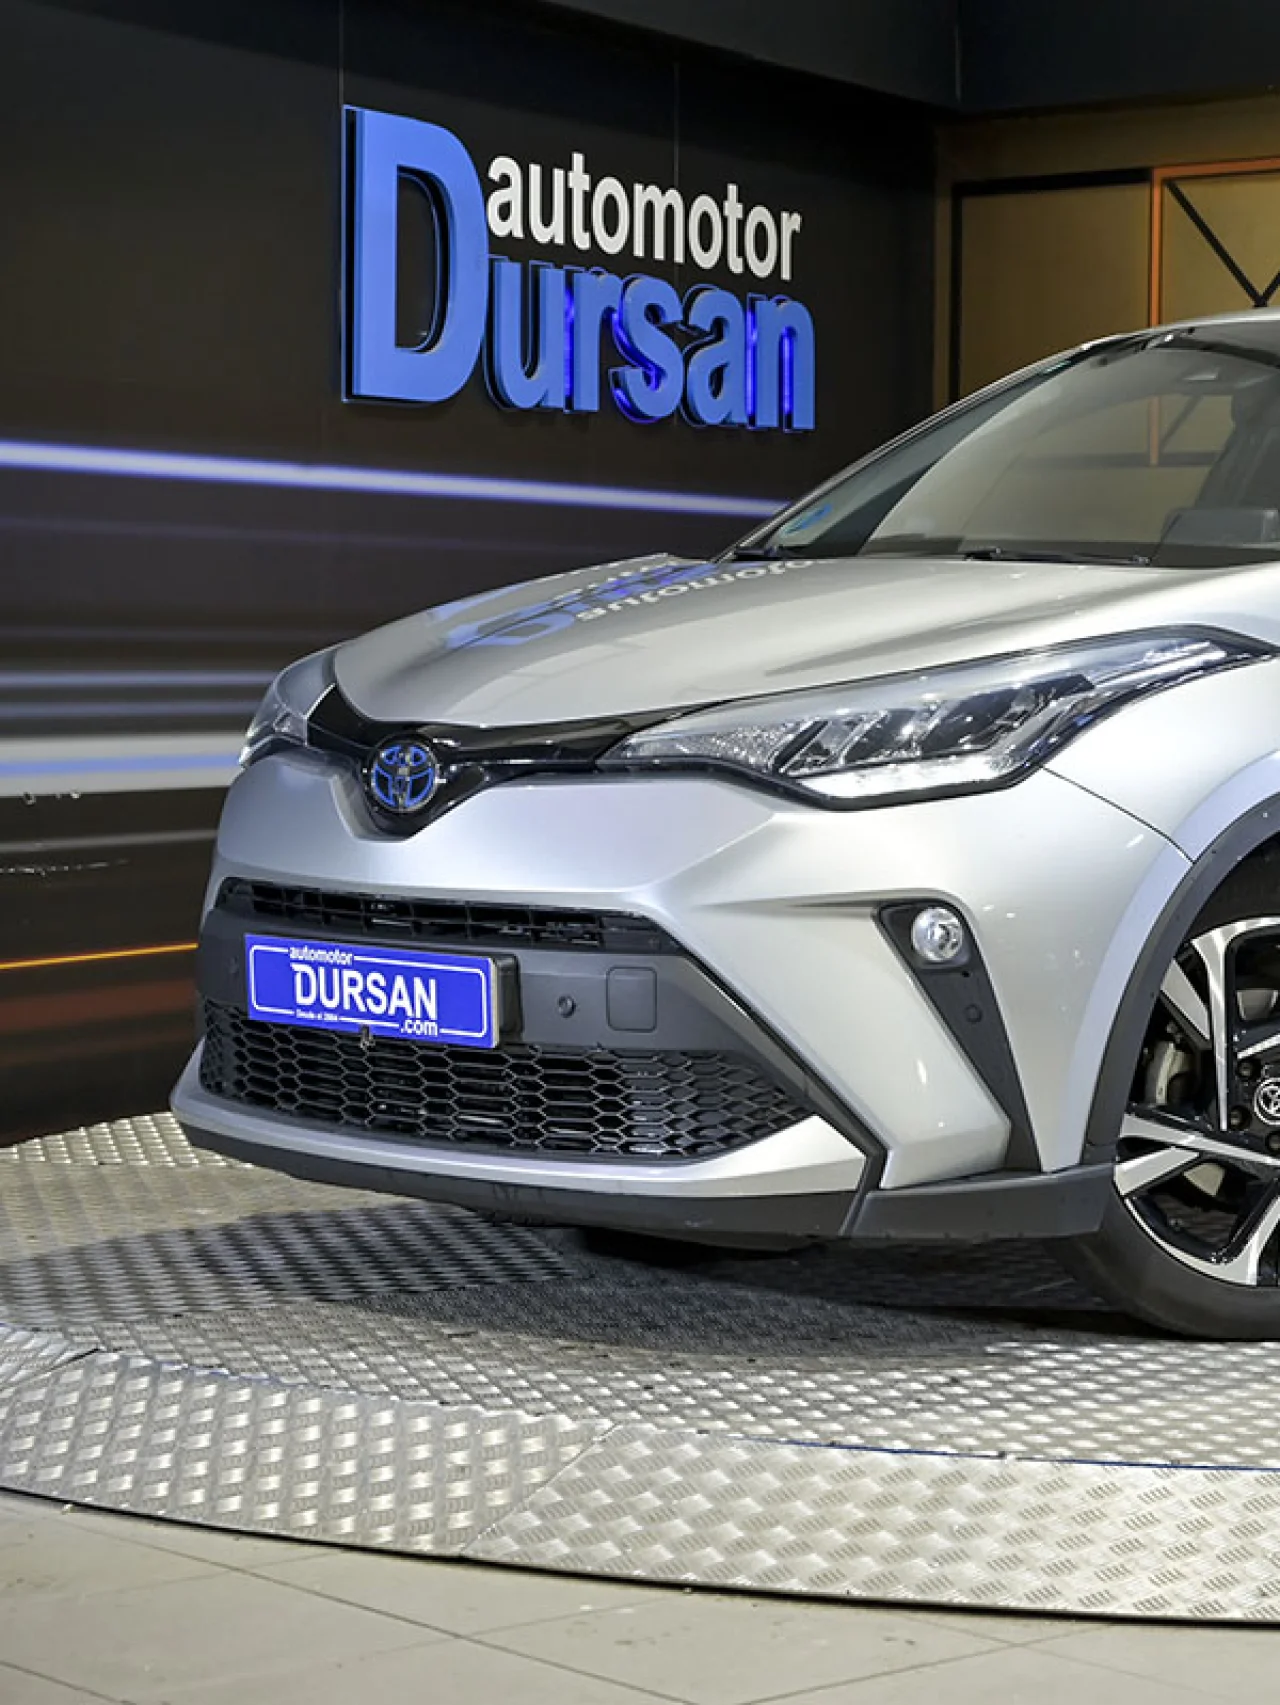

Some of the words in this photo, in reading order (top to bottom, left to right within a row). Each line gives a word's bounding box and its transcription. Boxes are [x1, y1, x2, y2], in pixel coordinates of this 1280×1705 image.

[486, 152, 801, 281] automotor
[342, 104, 815, 432] Dursan
[289, 945, 353, 966] automotor
[289, 962, 438, 1021] DURSAN
[400, 1019, 438, 1036] .com
